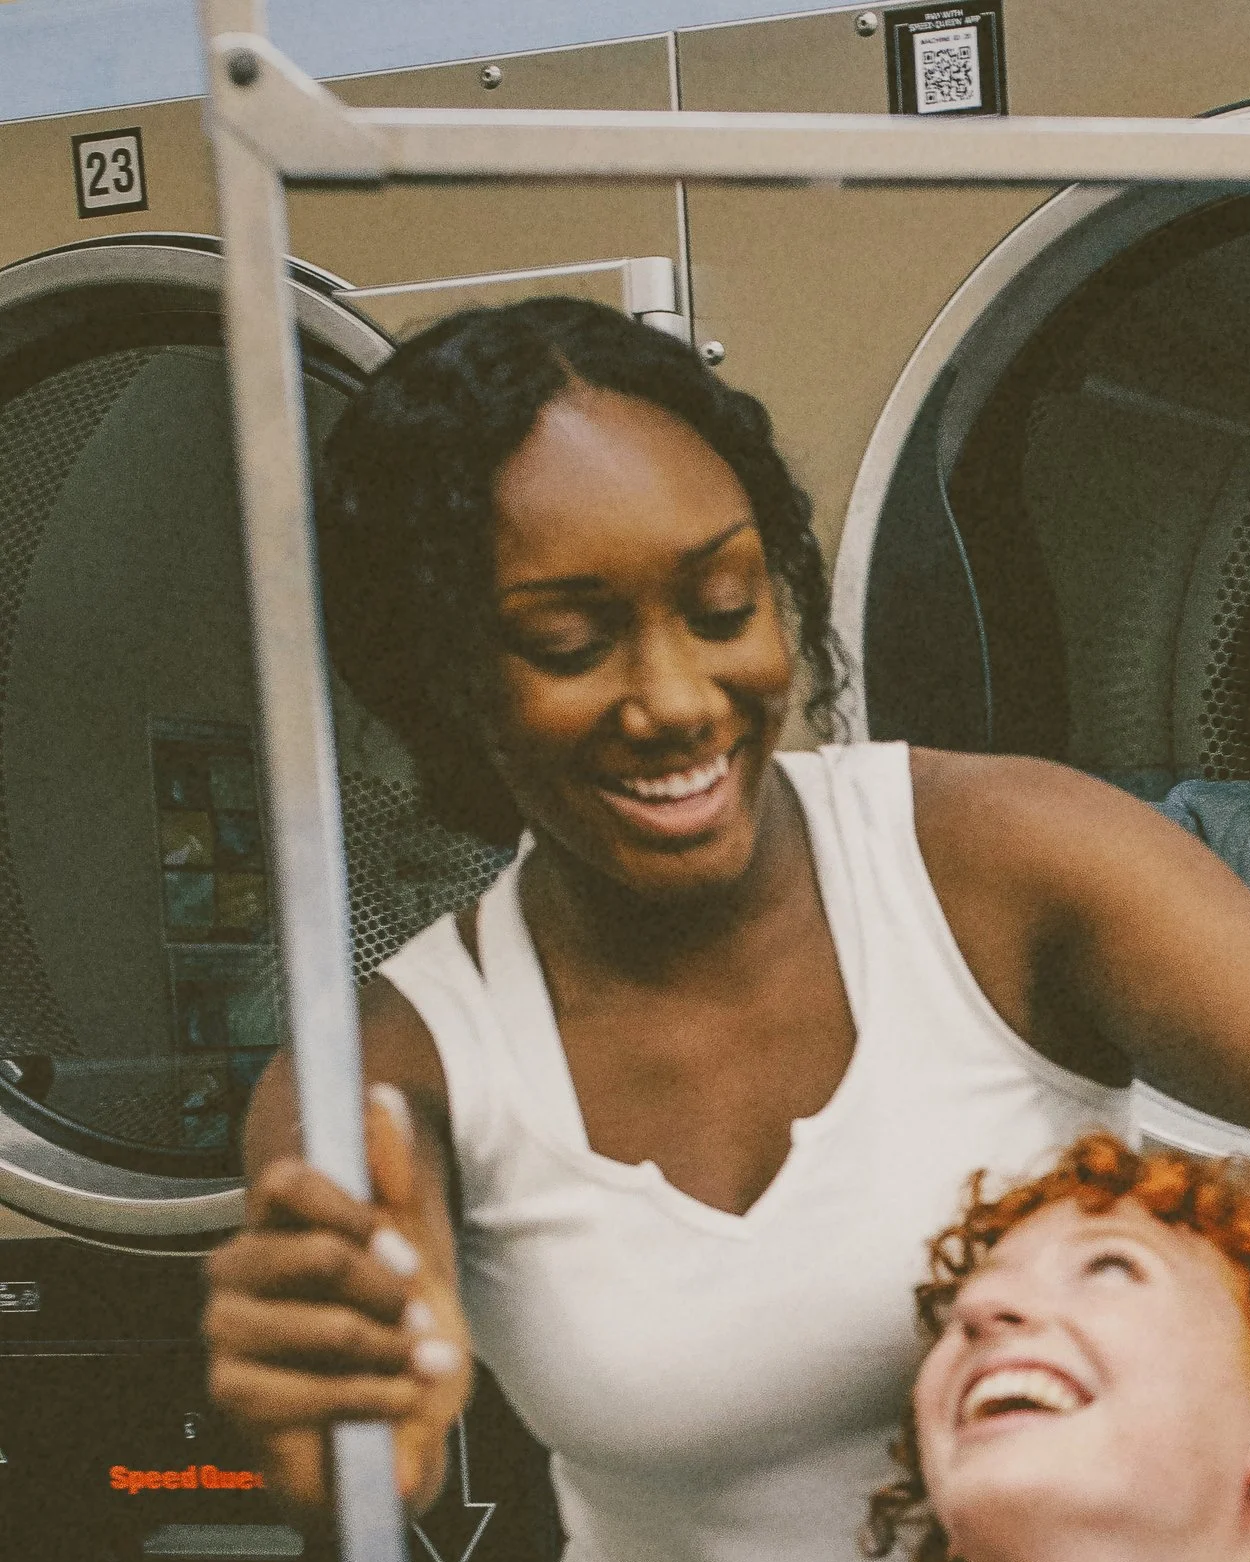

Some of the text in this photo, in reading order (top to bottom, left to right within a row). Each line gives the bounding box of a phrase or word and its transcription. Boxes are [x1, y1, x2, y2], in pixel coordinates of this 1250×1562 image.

[86, 148, 135, 197] 23
[109, 1464, 264, 1495] Speed Que
